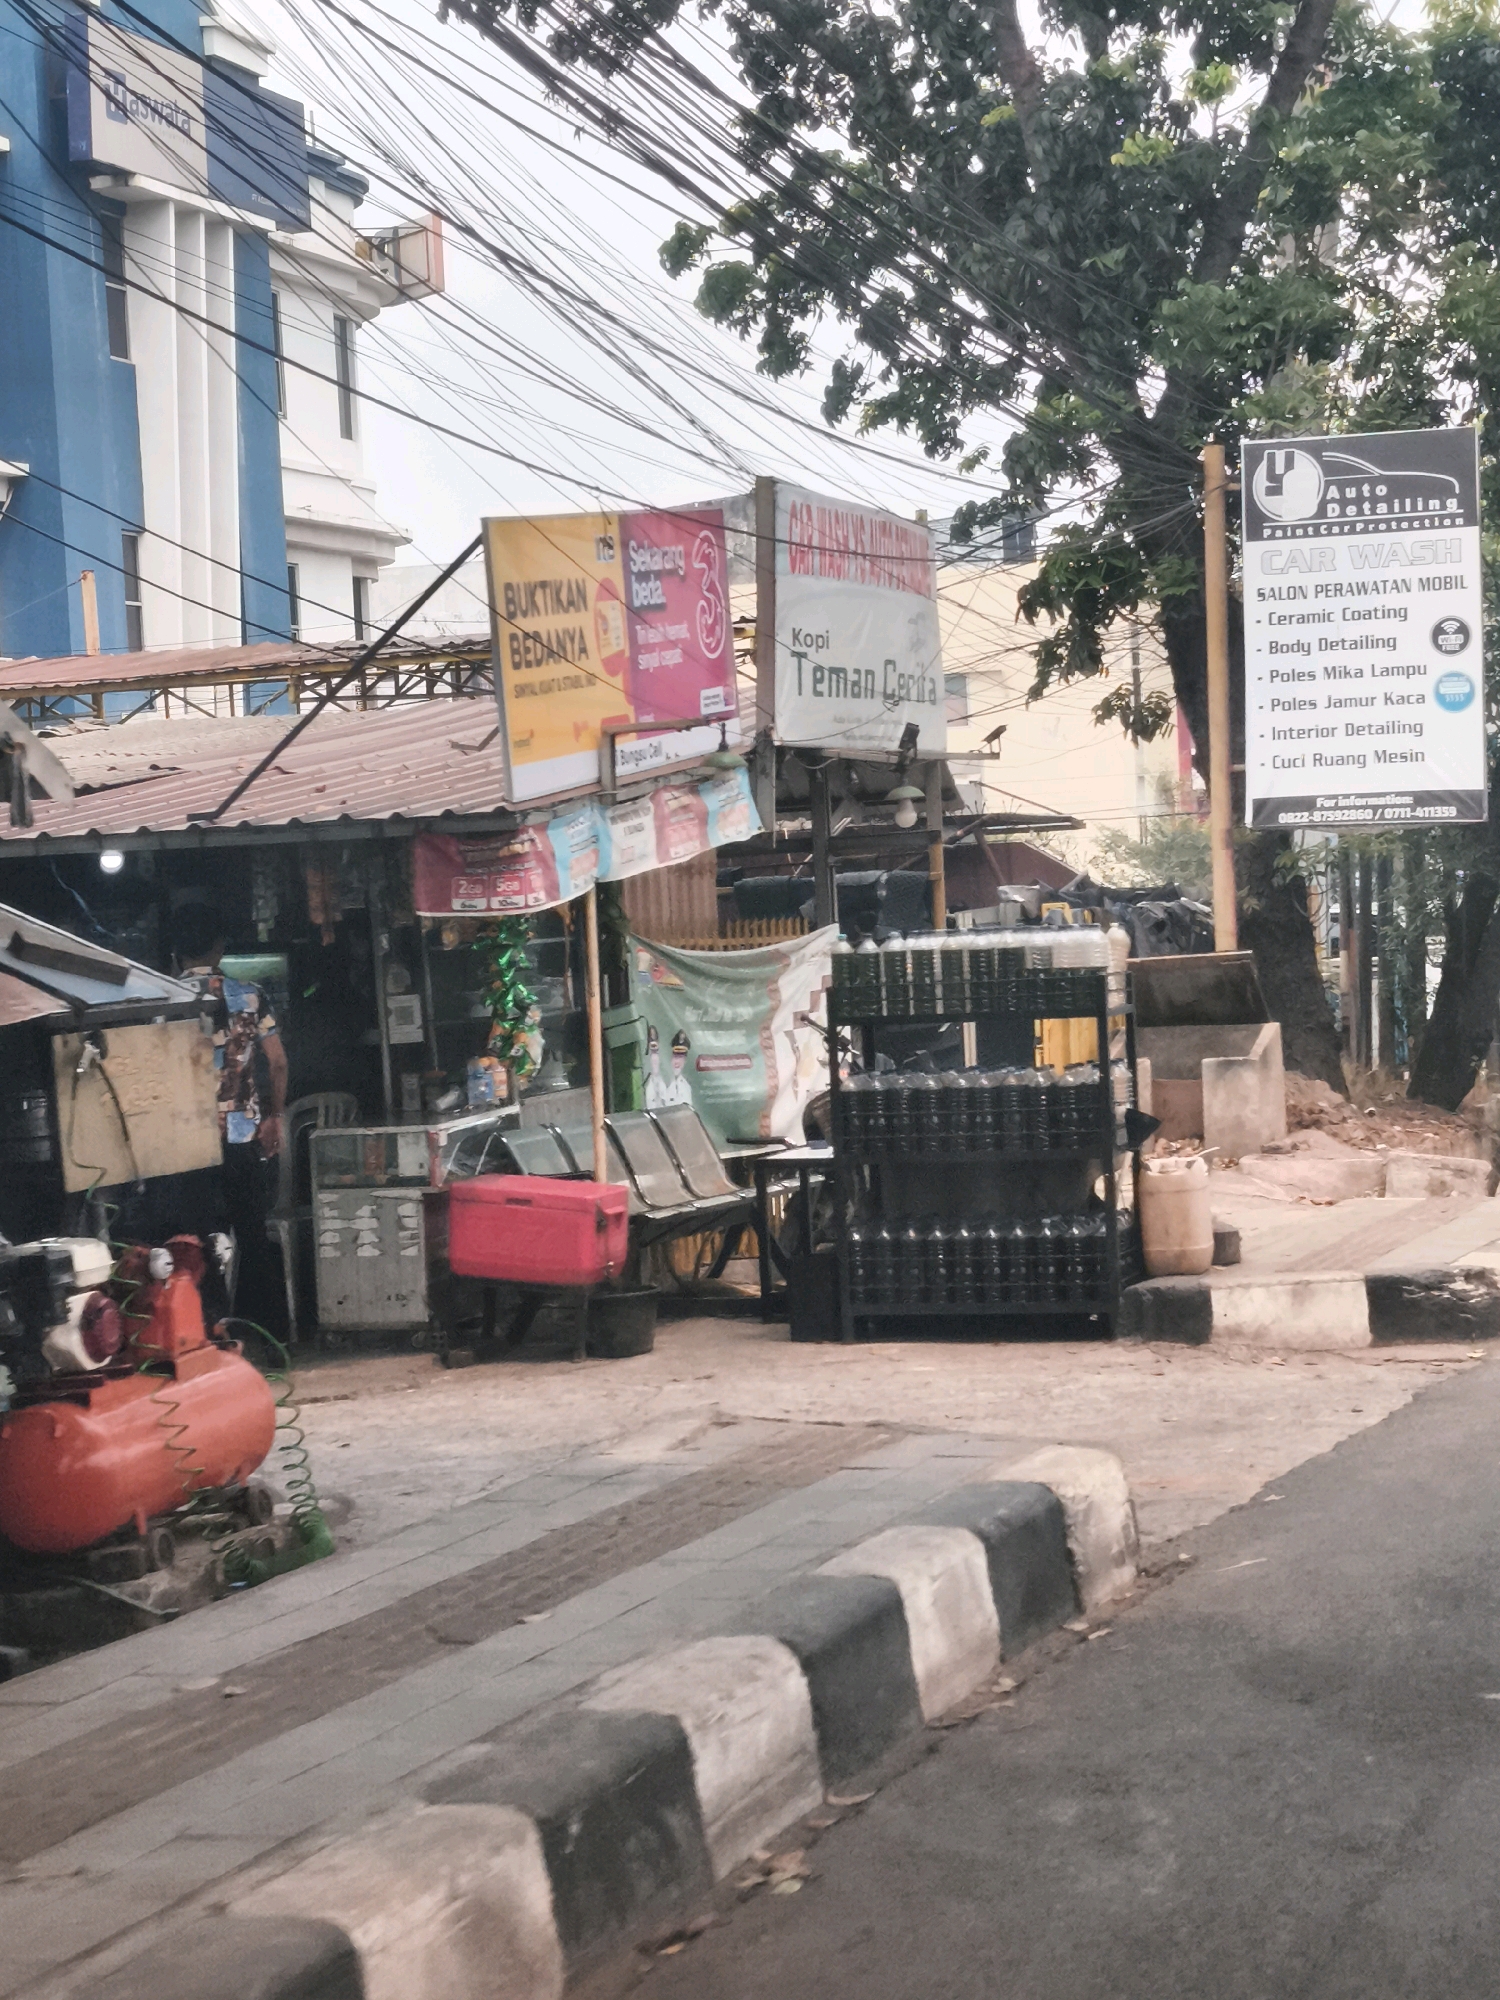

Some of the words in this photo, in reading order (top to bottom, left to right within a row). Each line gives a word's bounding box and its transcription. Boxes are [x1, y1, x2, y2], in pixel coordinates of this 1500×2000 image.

[1326, 483, 1388, 500] Auto
[1326, 497, 1458, 518] Detailing
[1263, 526, 1314, 539] Paint
[1320, 524, 1350, 535] Car
[1356, 516, 1464, 532] Protection
[788, 499, 814, 576] CAR
[816, 506, 850, 581] WASH
[629, 540, 685, 575] Sekarang
[1260, 546, 1336, 576] CAR
[1348, 538, 1462, 570] WASH
[504, 578, 589, 620] BUKTIKAN
[1257, 585, 1308, 602] SALON
[1314, 577, 1412, 598] PERAWATAN
[1418, 575, 1468, 592] MOBIL
[1268, 609, 1335, 626] Ceramic
[1342, 605, 1408, 622] Coating
[508, 626, 590, 671] BEDANYA
[792, 627, 830, 654] Kopi
[1268, 639, 1311, 656] Body
[1318, 634, 1397, 652] Detailing
[790, 651, 875, 700] Teman
[883, 659, 936, 706] Cerita
[1270, 668, 1316, 684] Poles
[1322, 665, 1364, 681] Mika
[1370, 662, 1427, 680] Lampu
[1270, 696, 1317, 712] Poles
[1324, 694, 1377, 710] Jamur
[1383, 692, 1426, 706] Kaca
[1272, 724, 1338, 740] Interior
[1344, 720, 1424, 738] Detailing
[1272, 753, 1306, 770] Cuci
[1312, 752, 1366, 768] Ruang
[1373, 749, 1426, 764] Mesin
[1316, 797, 1336, 808] For
[1337, 794, 1414, 807] information:
[1374, 808, 1382, 820] /
